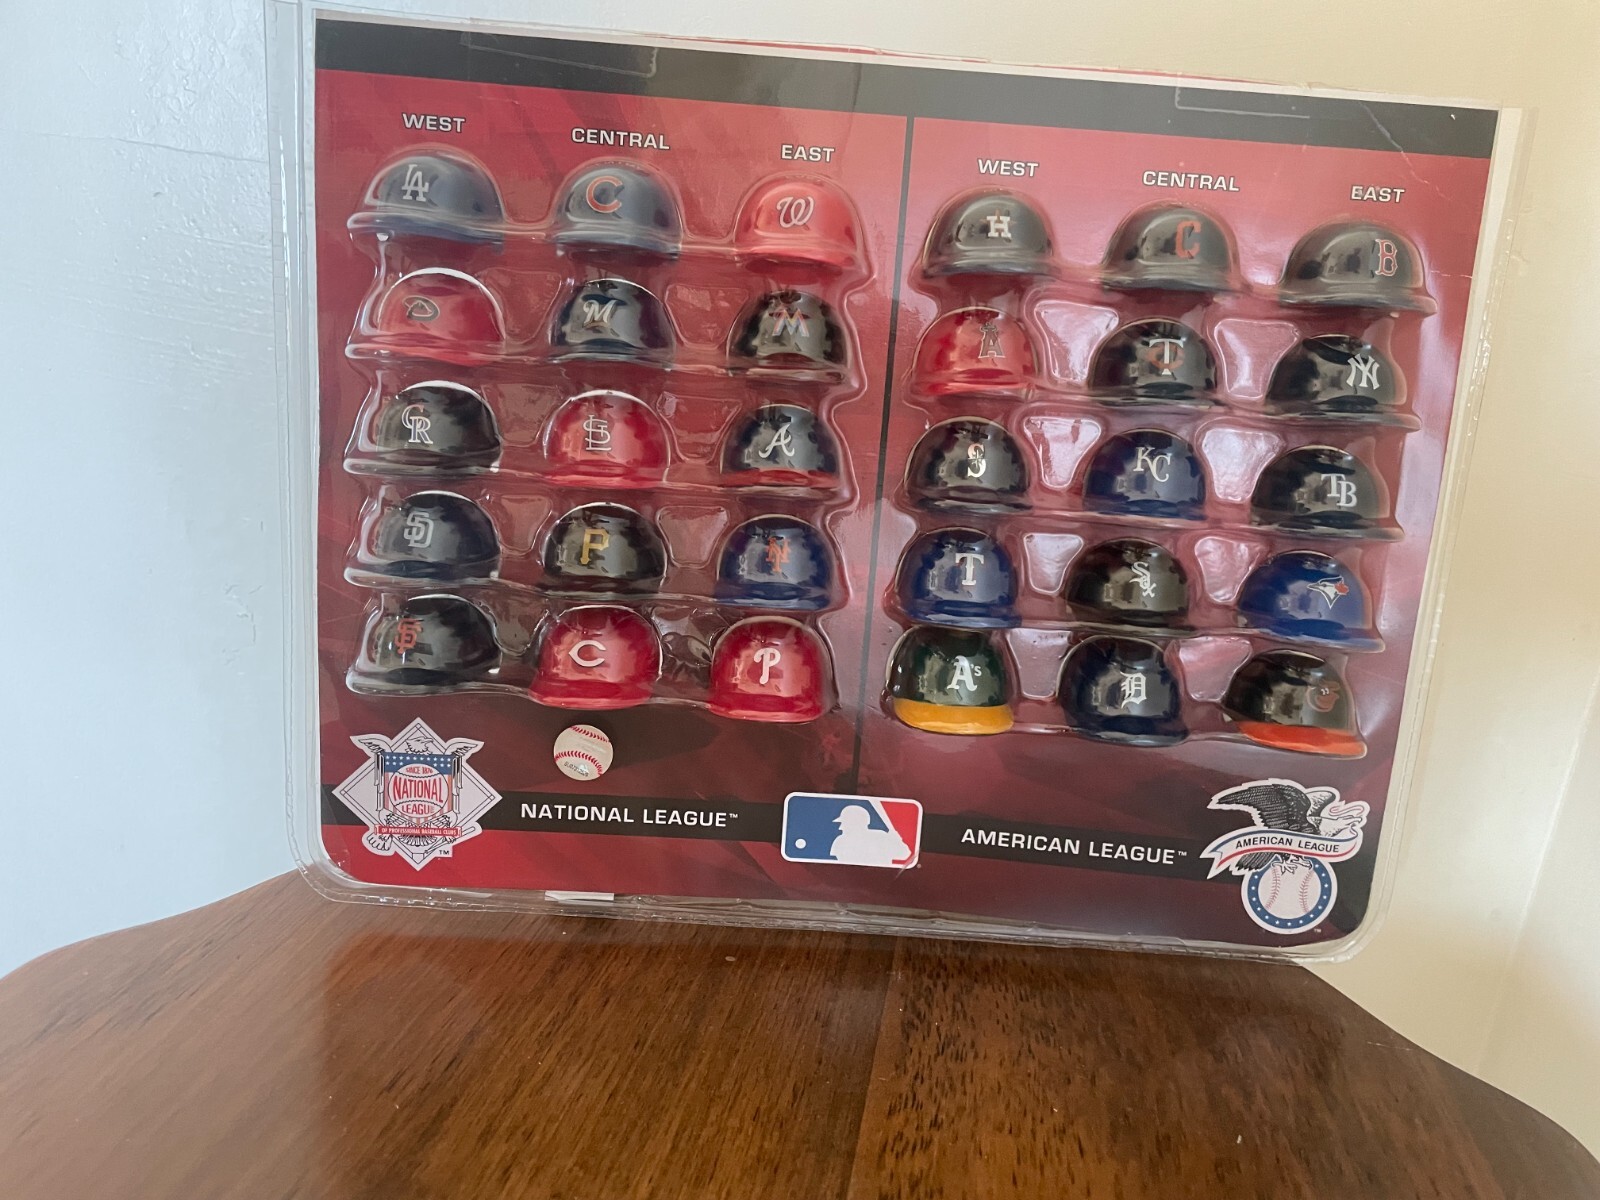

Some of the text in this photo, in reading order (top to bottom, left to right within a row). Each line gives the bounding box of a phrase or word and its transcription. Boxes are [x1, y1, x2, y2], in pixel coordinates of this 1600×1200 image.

[402, 113, 466, 133] WEST
[572, 128, 671, 150] CENTRAL
[781, 144, 836, 163] EAST
[977, 158, 1039, 177] WEST
[1142, 170, 1240, 192] CENTRAL
[401, 164, 430, 201] LA
[586, 175, 624, 213] C
[1351, 185, 1406, 203] EAST
[776, 196, 815, 228] W
[986, 215, 1012, 239] H
[1175, 220, 1201, 259] C
[1374, 238, 1399, 277] B
[1346, 353, 1380, 390] NY
[758, 422, 796, 458] A
[1133, 446, 1173, 483] KC
[1320, 473, 1358, 508] TB
[579, 528, 610, 565] P
[955, 552, 985, 587] T
[568, 639, 607, 668] C
[753, 647, 782, 685] P
[393, 775, 444, 803] NATIONAL
[401, 803, 435, 815] LEAGUE
[521, 803, 635, 823] NATIONAL
[961, 828, 1081, 855] AMERICAN
[1235, 836, 1340, 853] AMERICAN LEAGUE
